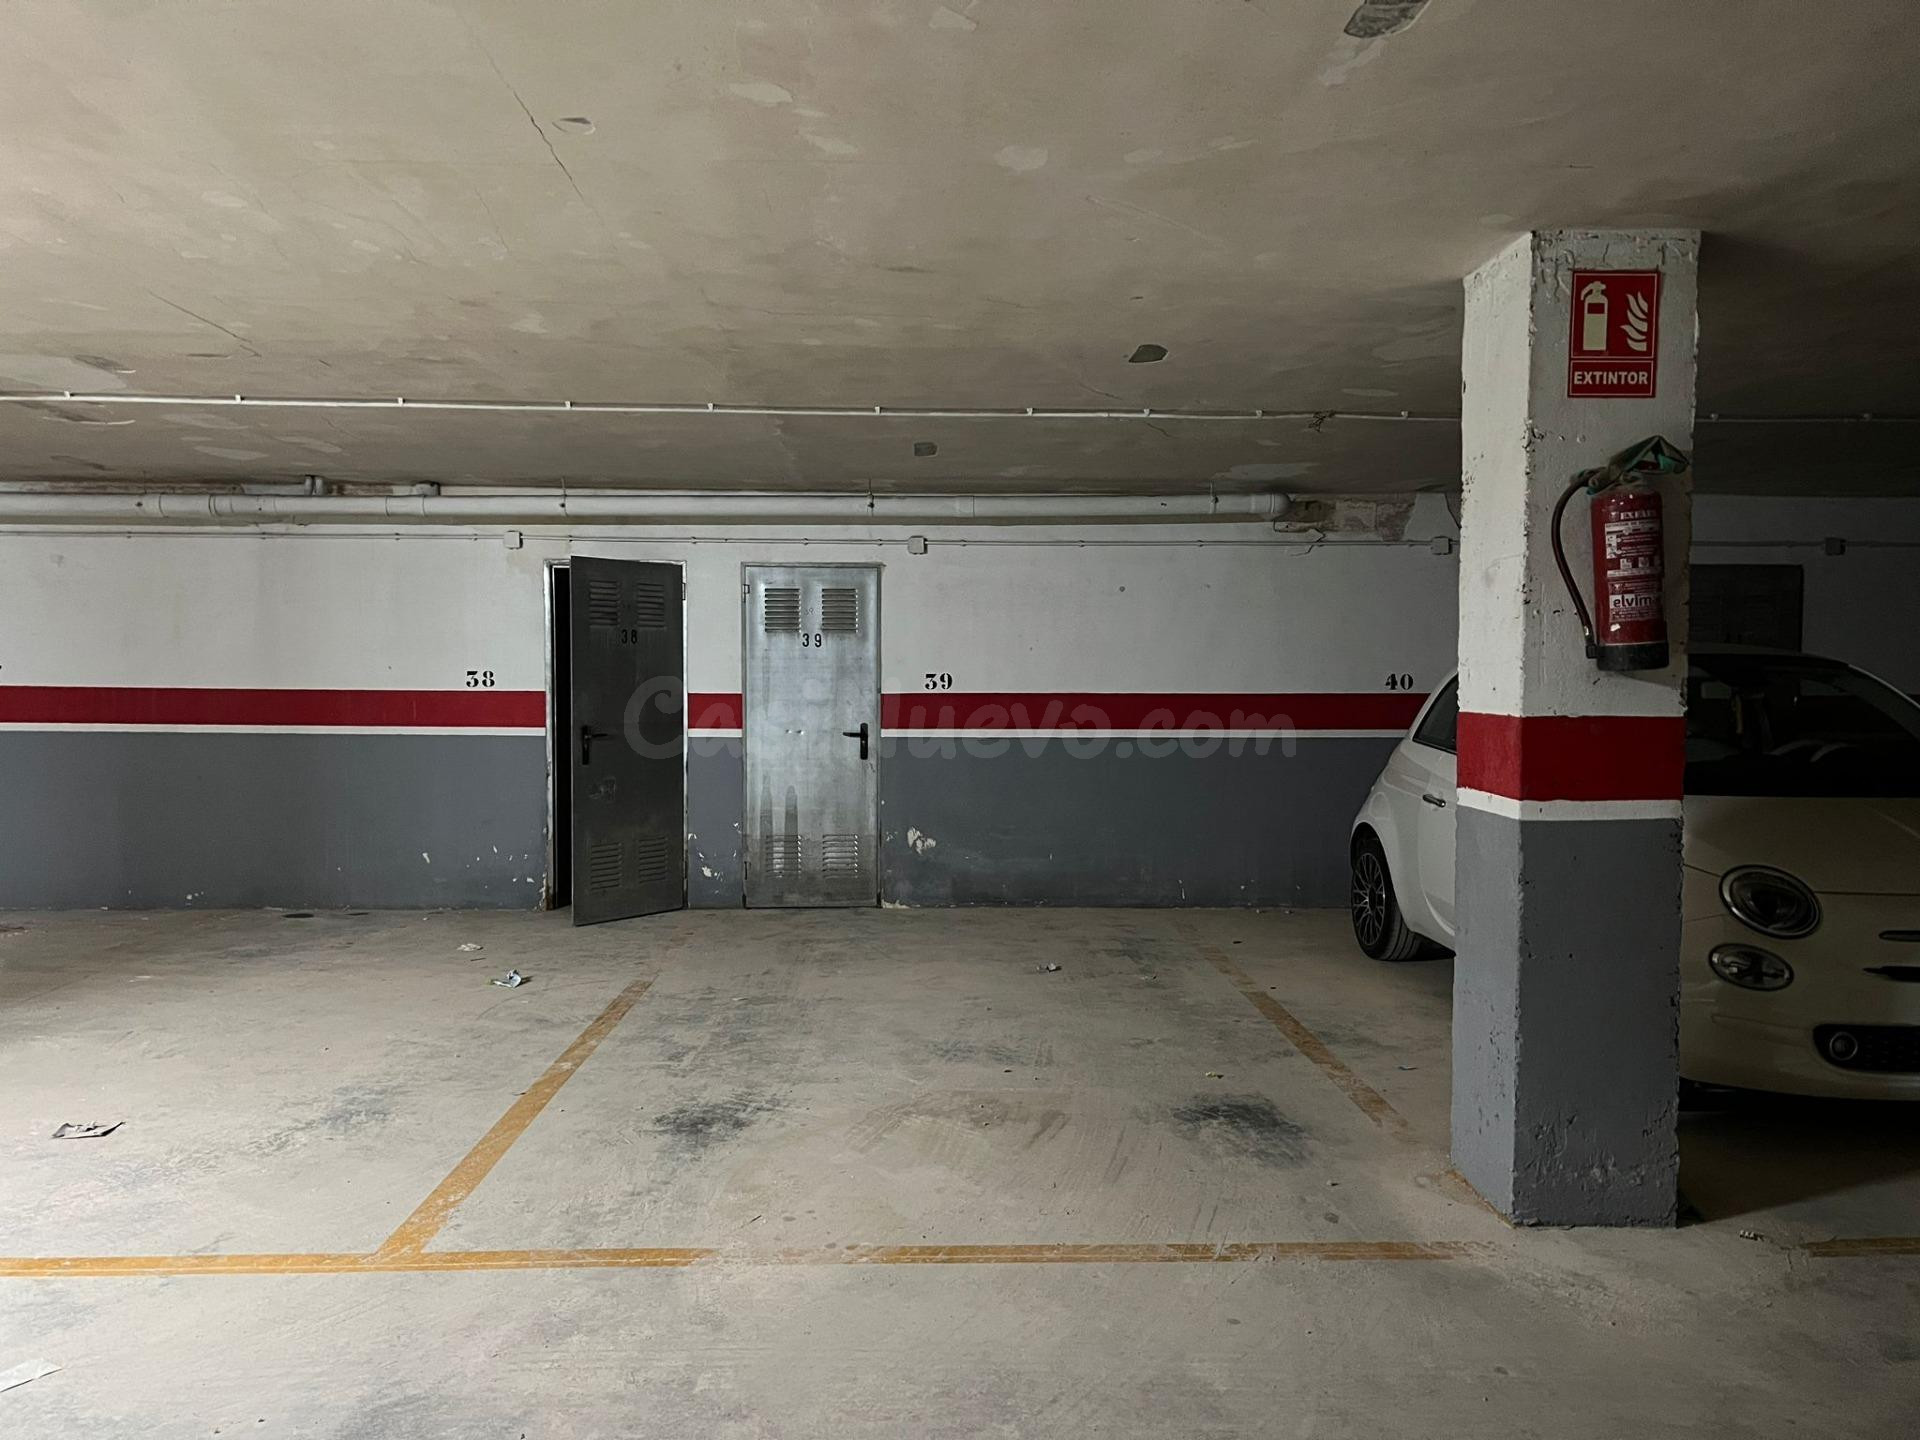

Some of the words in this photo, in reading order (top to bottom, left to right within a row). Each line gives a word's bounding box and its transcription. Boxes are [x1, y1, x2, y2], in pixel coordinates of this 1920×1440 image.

[1573, 371, 1648, 385] EXTINTOR
[621, 629, 637, 644] 38
[802, 633, 822, 648] 39
[466, 670, 495, 688] 38
[925, 672, 953, 690] 39
[1385, 673, 1414, 690] 40
